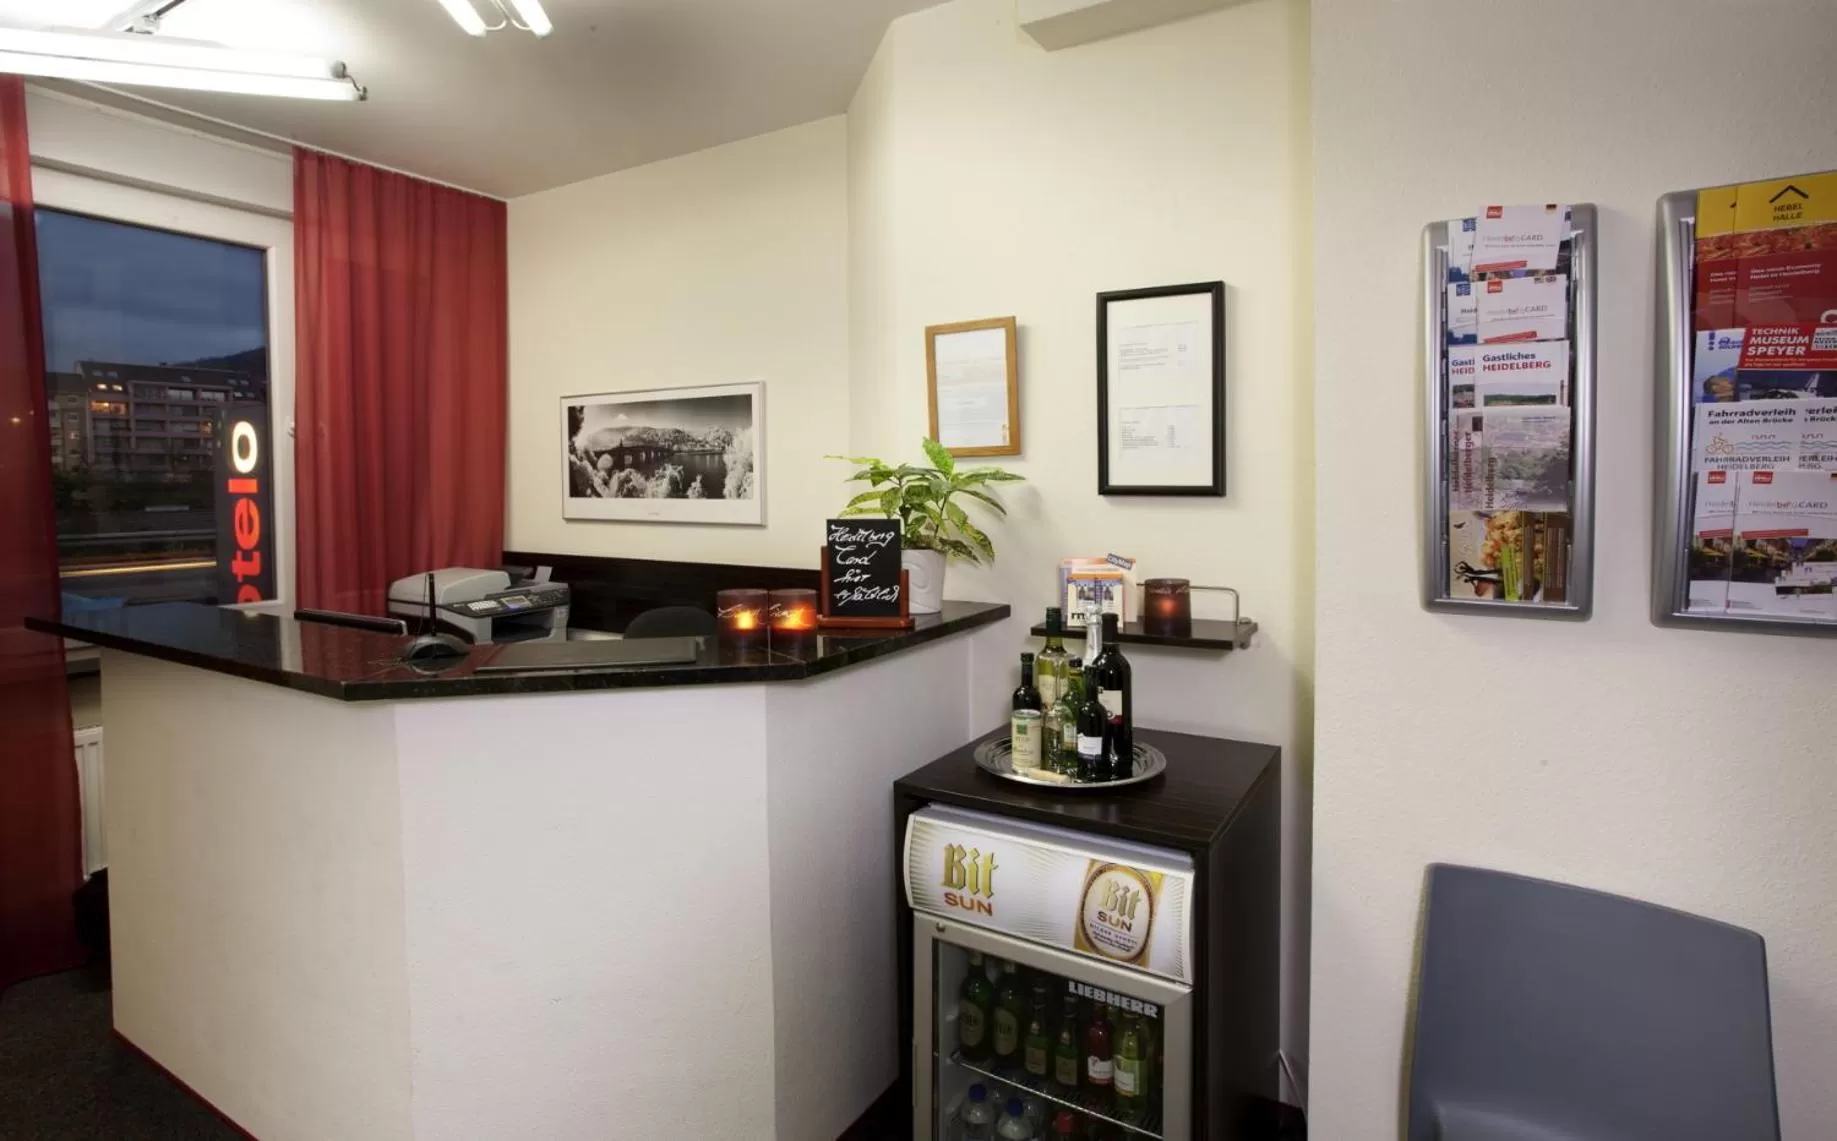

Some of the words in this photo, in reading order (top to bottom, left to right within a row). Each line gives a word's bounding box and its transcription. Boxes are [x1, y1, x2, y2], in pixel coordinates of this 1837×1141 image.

[1752, 327, 1800, 336] TECHNIK
[1750, 336, 1809, 345] MUSEUM
[1747, 345, 1806, 356] SPEYER
[1482, 352, 1536, 363] Gastliches
[1482, 361, 1551, 373] HEIDELBERG
[1707, 407, 1797, 418] Fahrradverleih
[940, 842, 999, 899] Bit
[944, 891, 993, 917] SUN
[1099, 878, 1141, 921] Bit
[1097, 910, 1133, 933] SUN
[1068, 980, 1160, 1019] LIEBHERR
